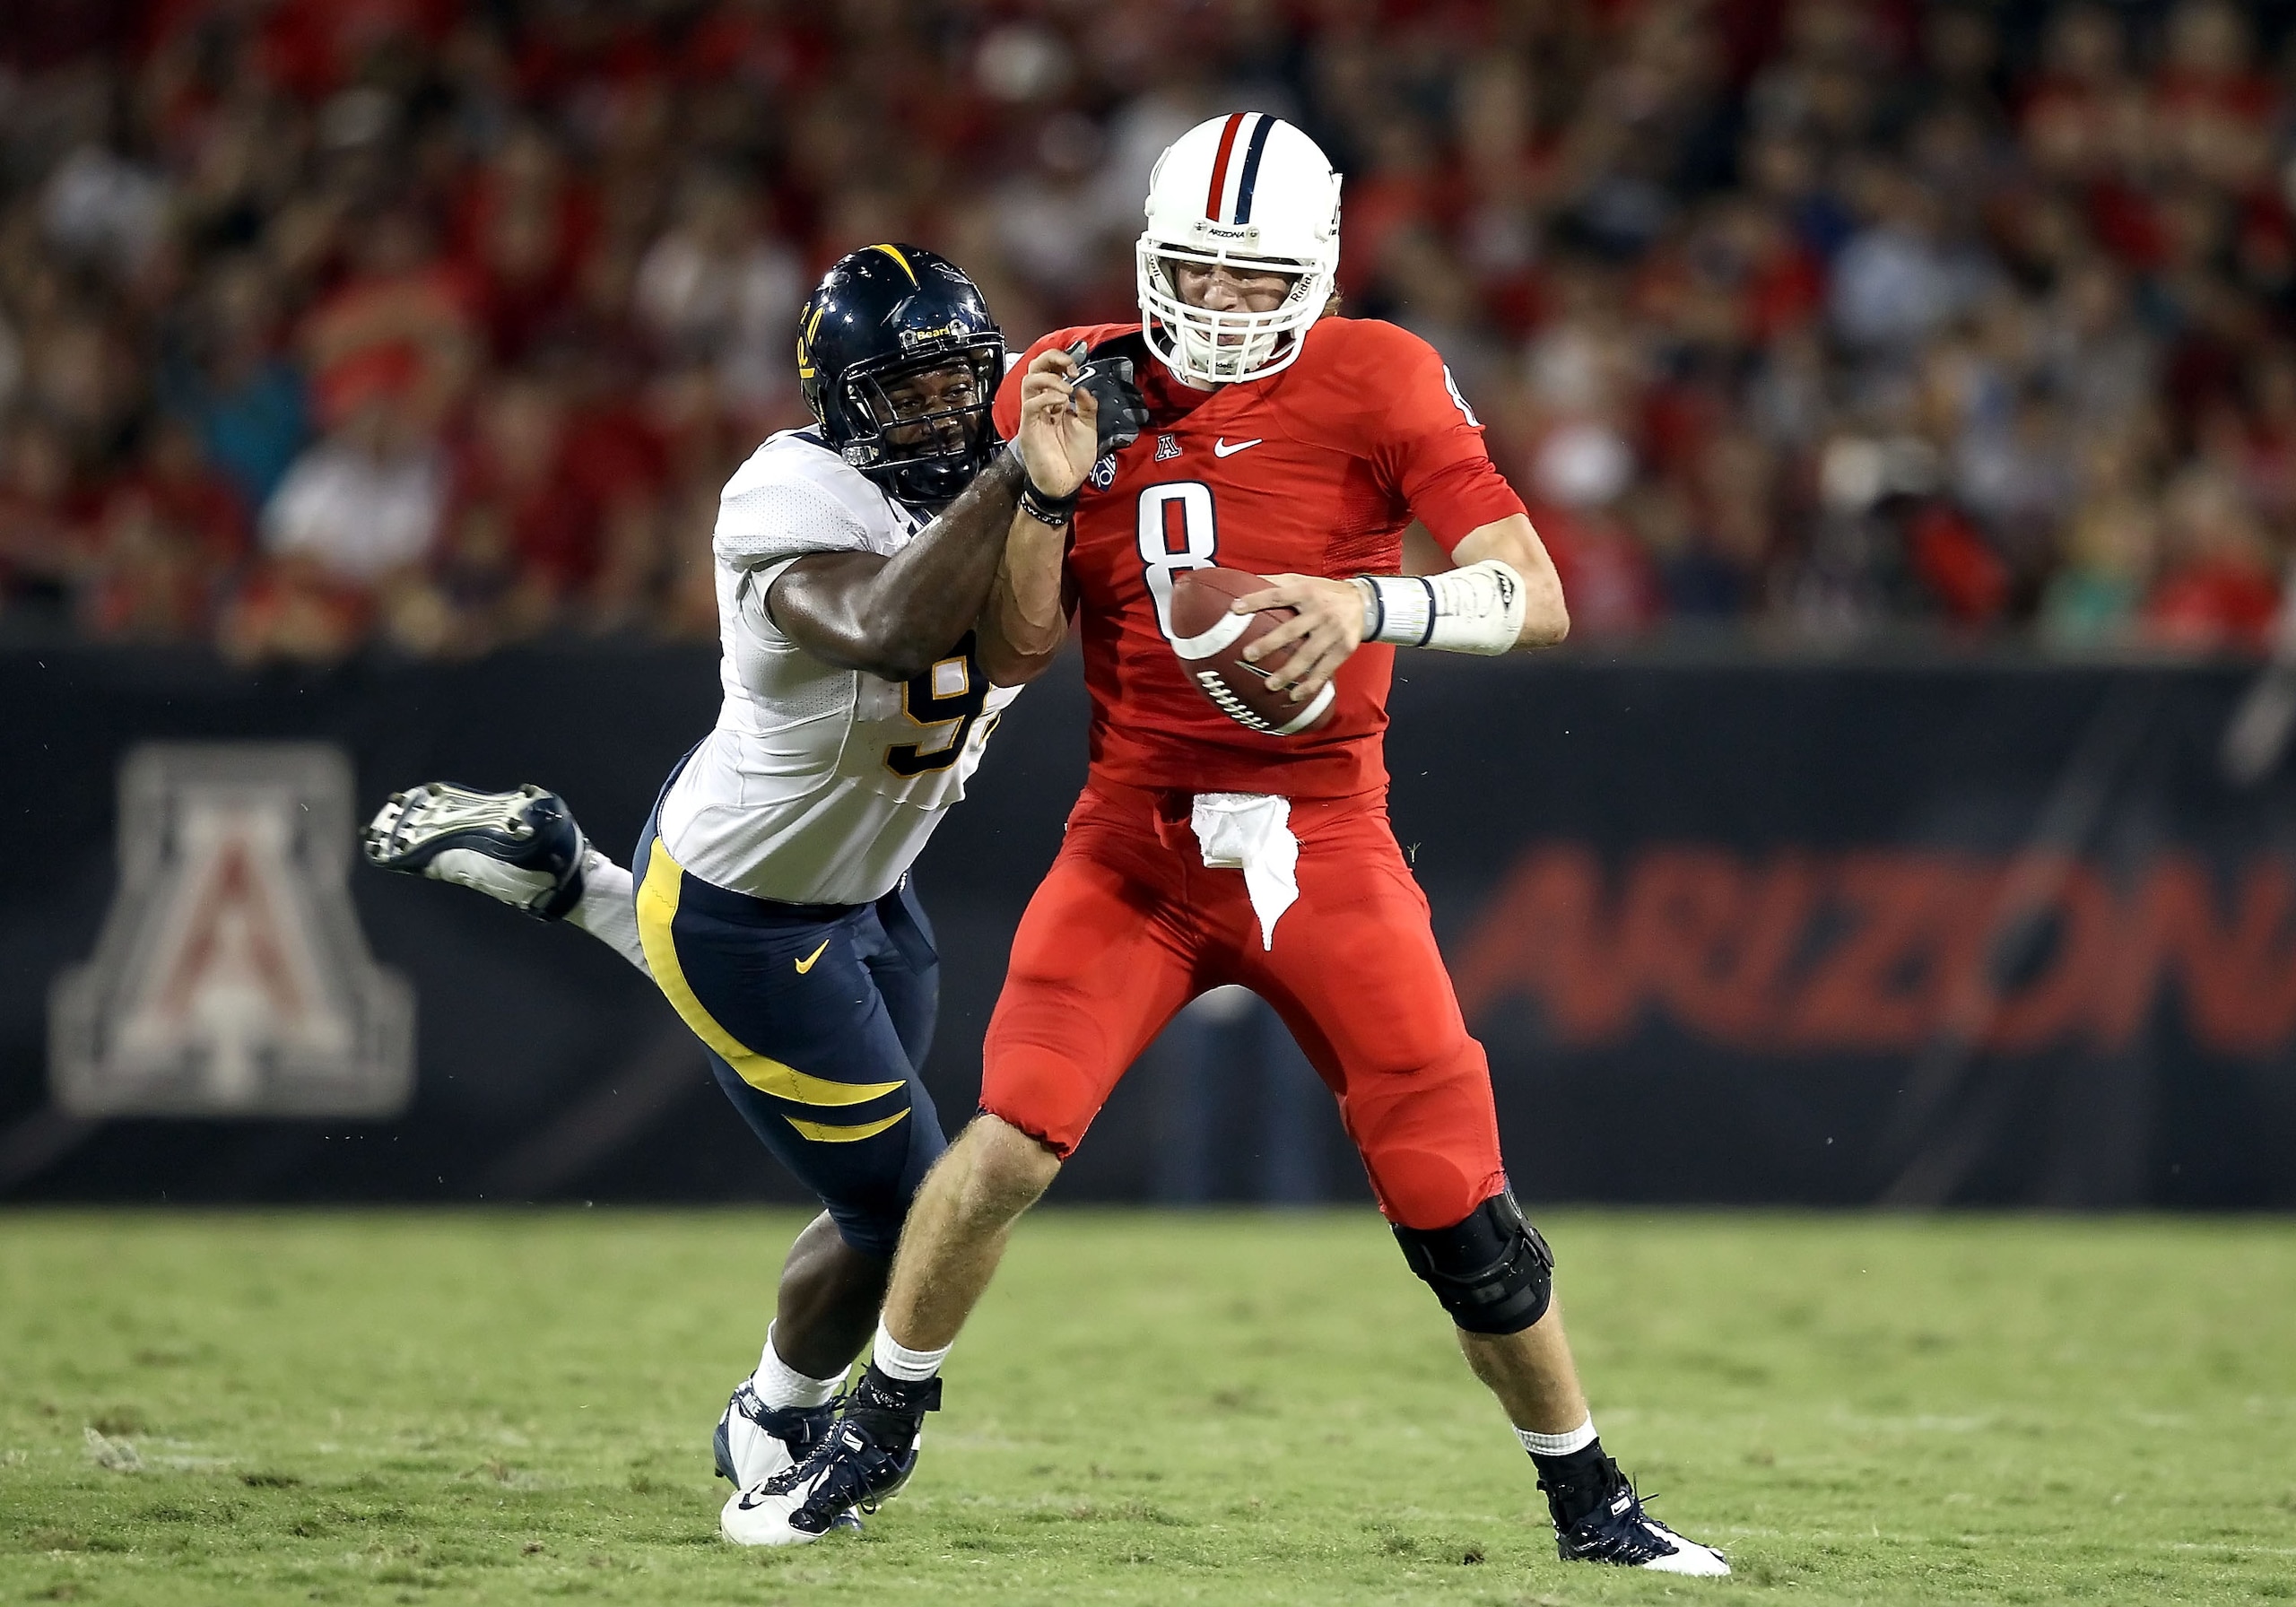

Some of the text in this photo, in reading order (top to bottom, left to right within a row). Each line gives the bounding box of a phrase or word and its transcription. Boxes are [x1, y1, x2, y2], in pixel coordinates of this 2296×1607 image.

[1209, 229, 1245, 238] ARIZONA
[1136, 479, 1218, 641] 8
[45, 741, 418, 1117] A
[1451, 843, 2296, 1058] ARIZON
